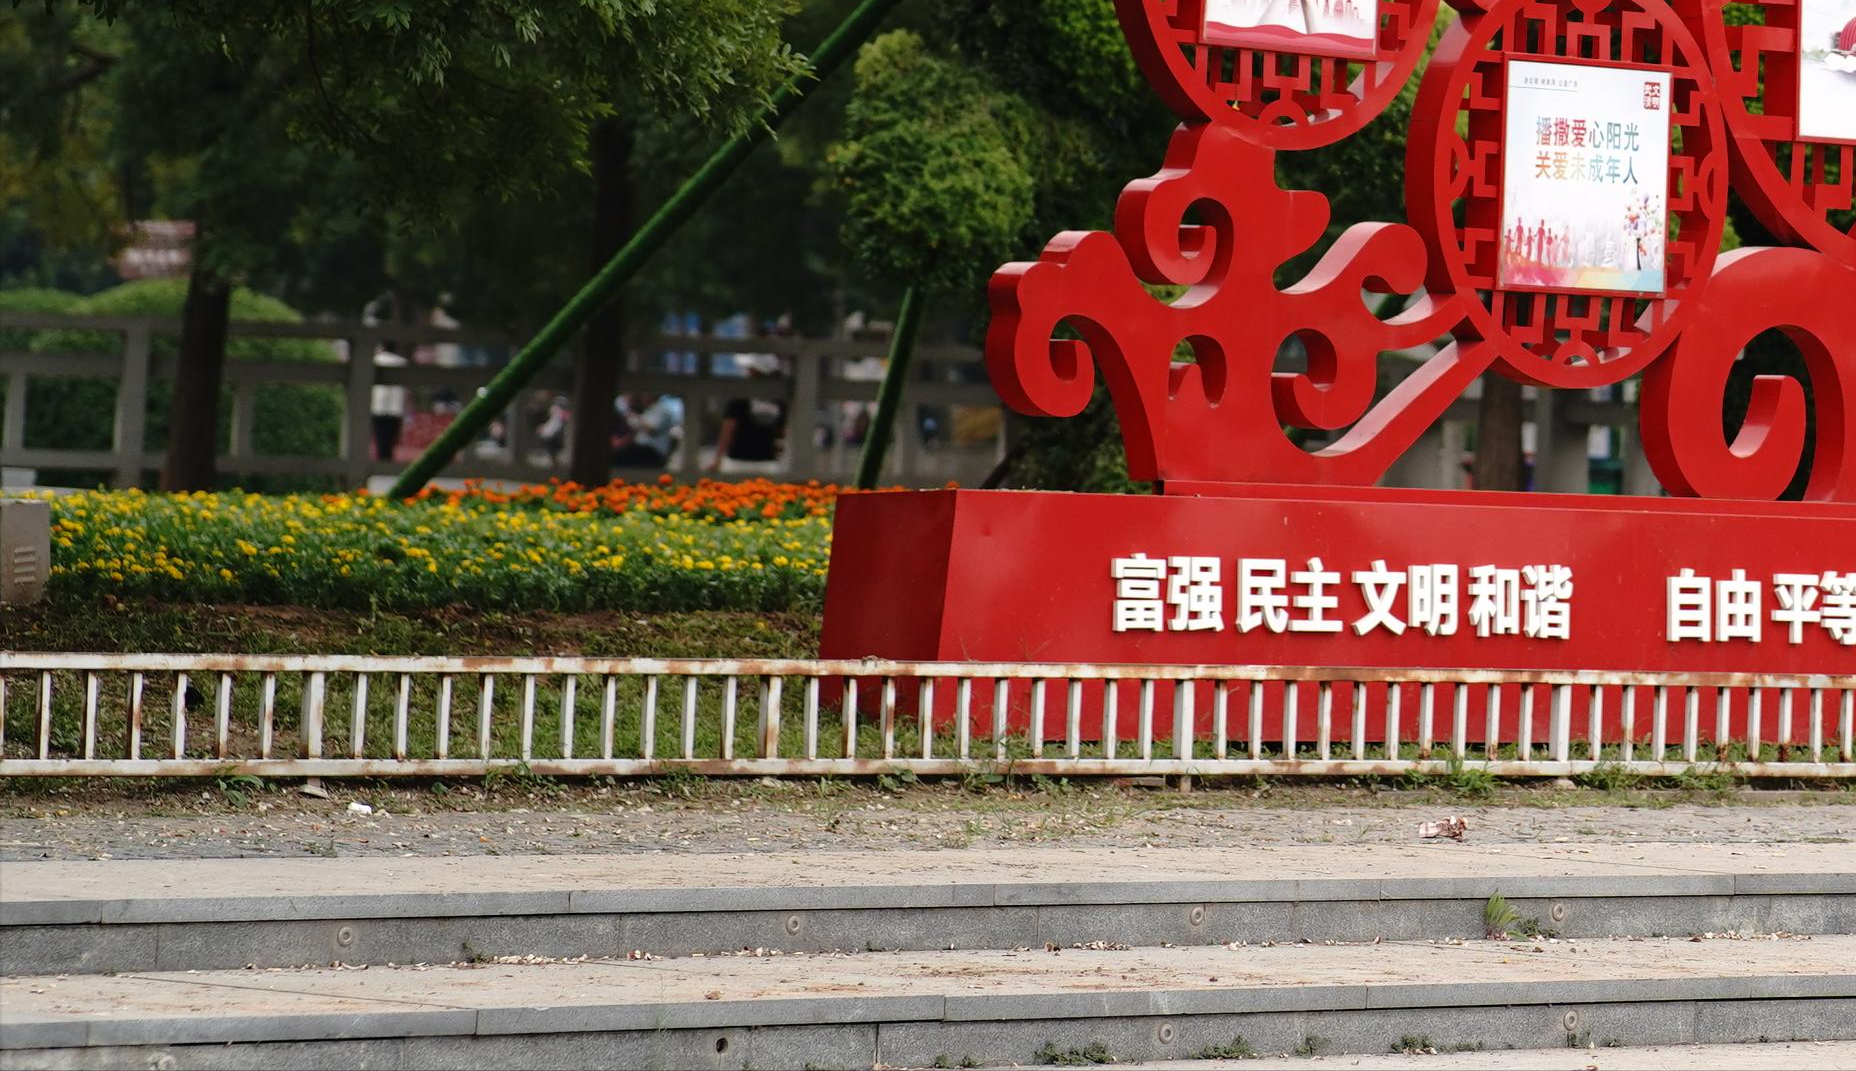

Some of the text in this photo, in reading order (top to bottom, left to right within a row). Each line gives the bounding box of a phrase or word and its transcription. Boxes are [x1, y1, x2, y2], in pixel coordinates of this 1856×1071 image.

[1536, 116, 1640, 152] 播撒爱心阳光
[1535, 151, 1639, 185] 关爱未成年人
[1111, 553, 1574, 640] 富强民主文明和谐
